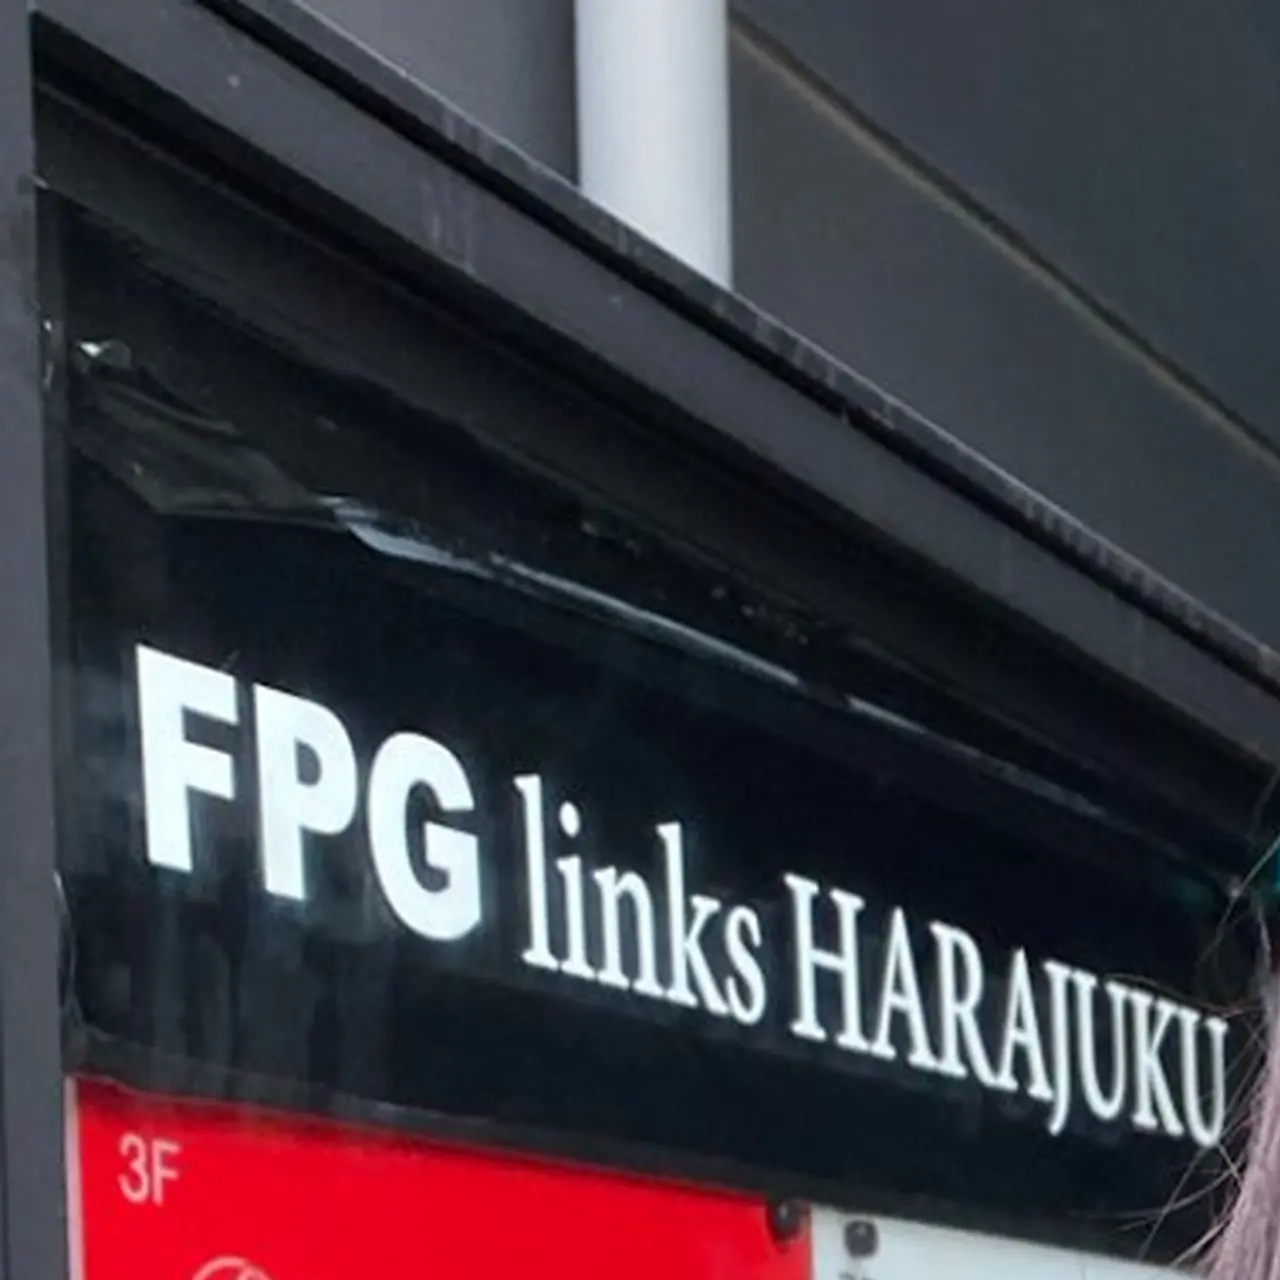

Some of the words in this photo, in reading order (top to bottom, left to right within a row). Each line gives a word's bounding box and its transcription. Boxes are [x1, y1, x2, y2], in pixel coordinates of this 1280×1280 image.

[135, 643, 483, 943] FPG
[512, 773, 768, 1026] links
[784, 872, 1229, 1149] HARAJUKU
[119, 1132, 182, 1204] 3F
